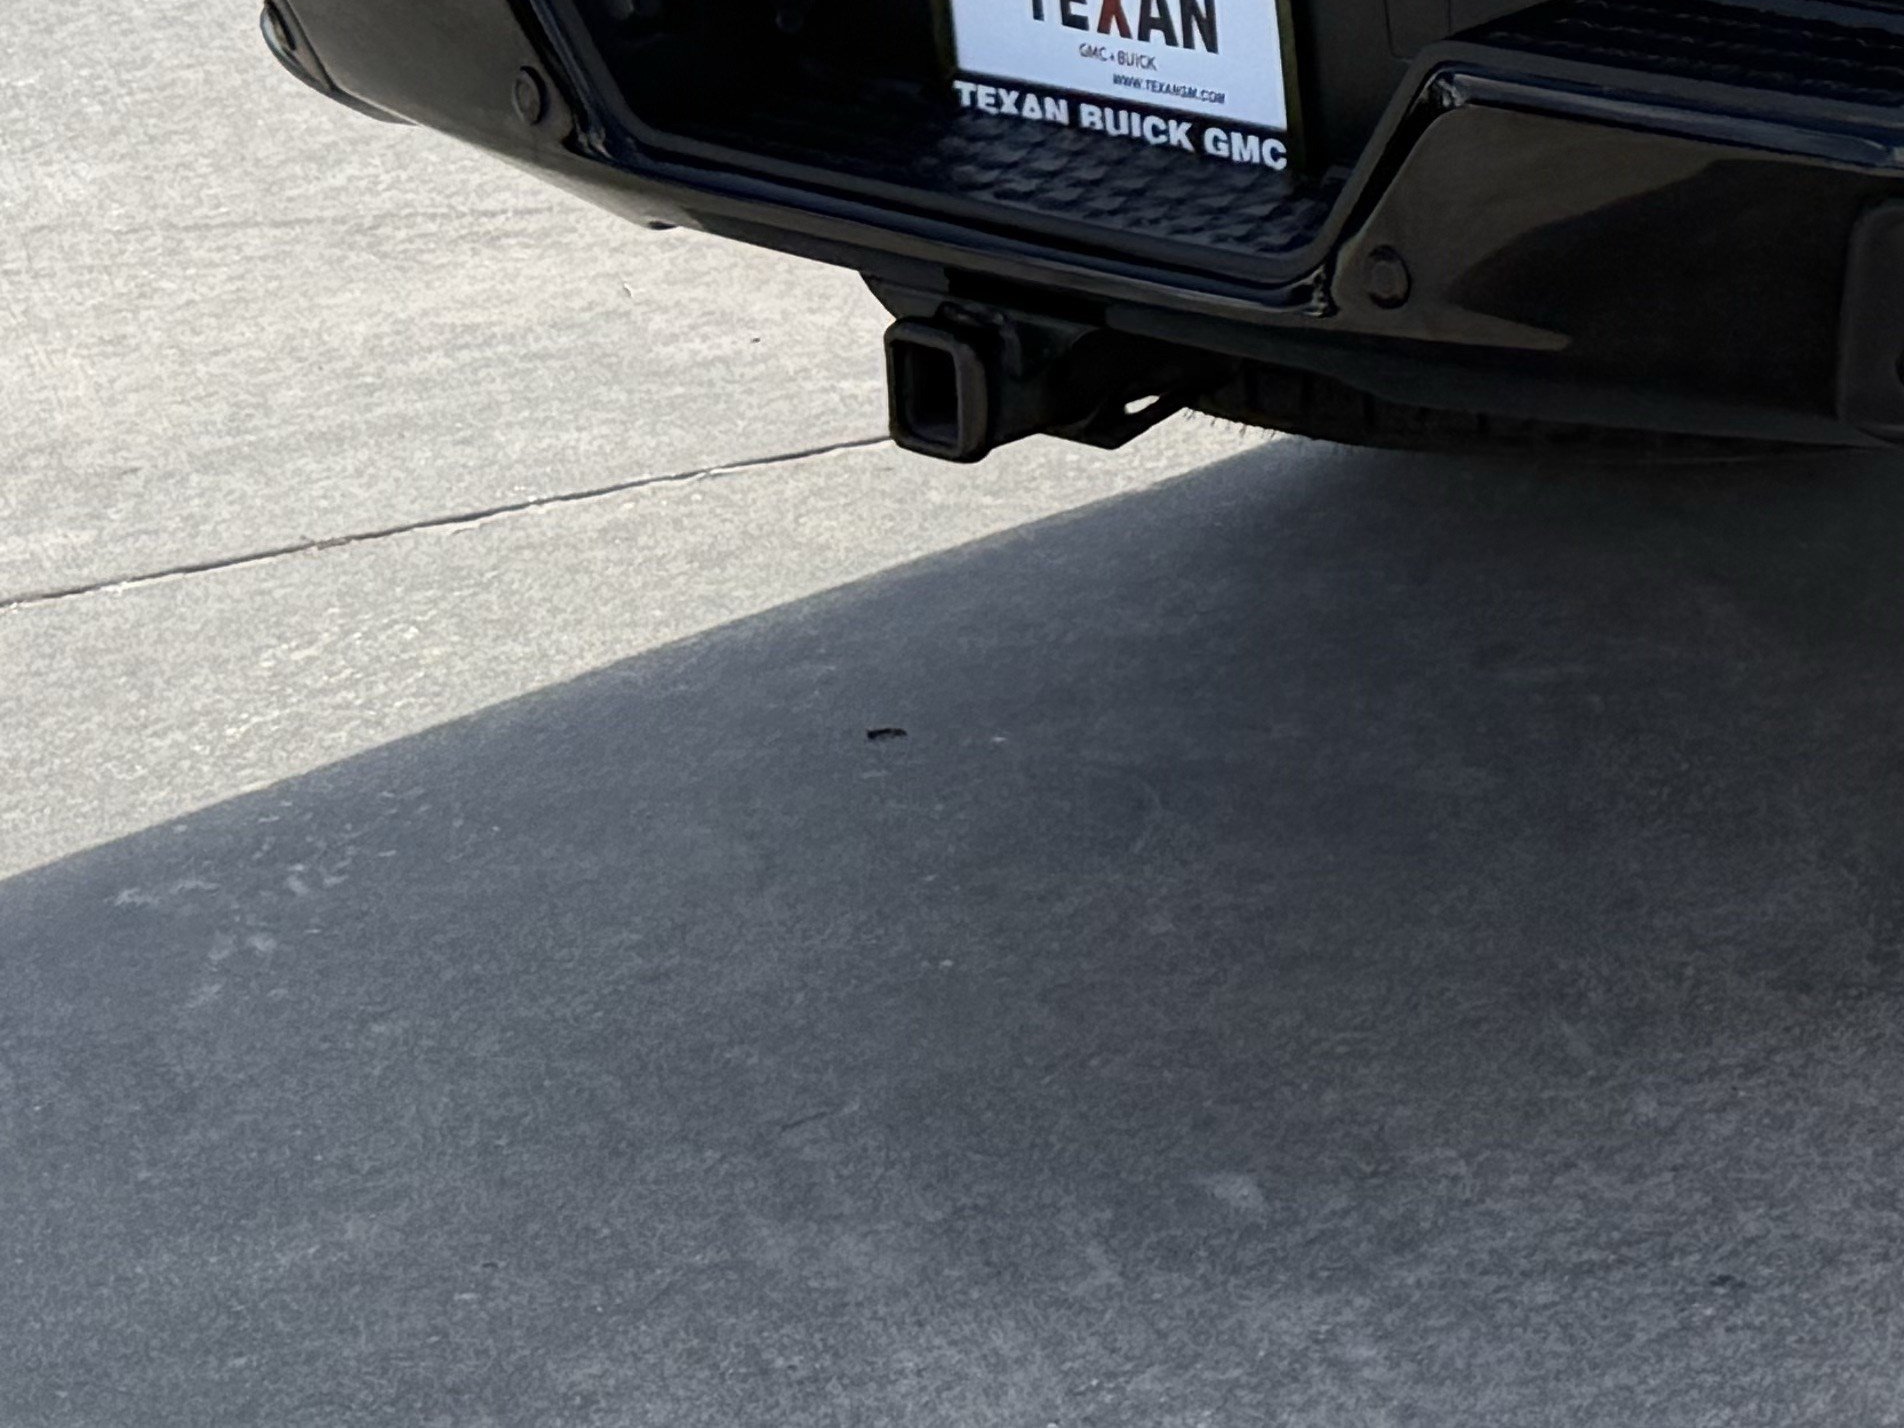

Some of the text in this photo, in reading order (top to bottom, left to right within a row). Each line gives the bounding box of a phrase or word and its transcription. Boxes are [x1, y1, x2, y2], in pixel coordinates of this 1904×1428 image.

[953, 79, 1289, 172] TEXAN BUICK GMC
